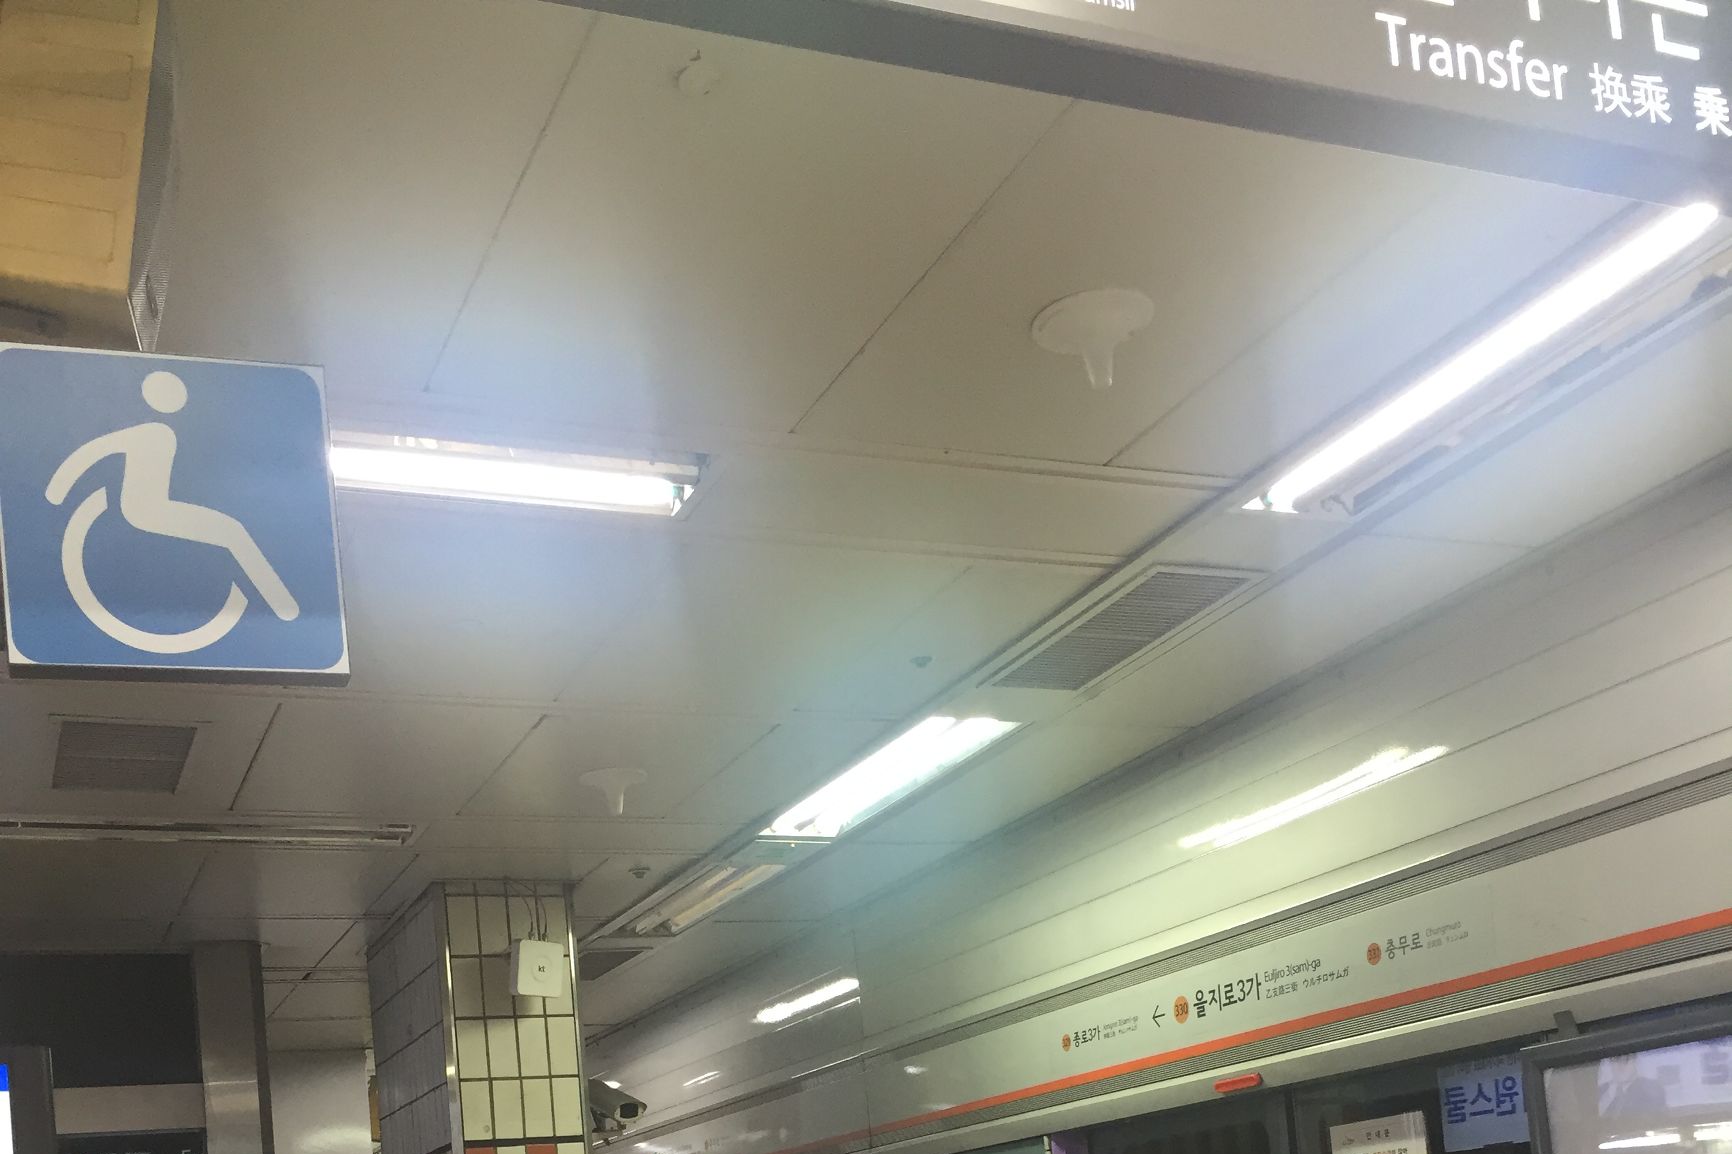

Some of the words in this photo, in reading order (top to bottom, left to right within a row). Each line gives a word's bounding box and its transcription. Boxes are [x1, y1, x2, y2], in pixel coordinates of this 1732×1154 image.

[1375, 12, 1568, 100] Transfer
[1589, 62, 1672, 124] 换乘
[1385, 932, 1423, 960] 충무로
[1264, 968, 1285, 983] Euljiro
[1285, 958, 1321, 978] 3(sam)-ga
[1193, 972, 1262, 1018] 을지로3가
[1174, 1002, 1188, 1018] 330
[1073, 1024, 1101, 1048] 종로3가
